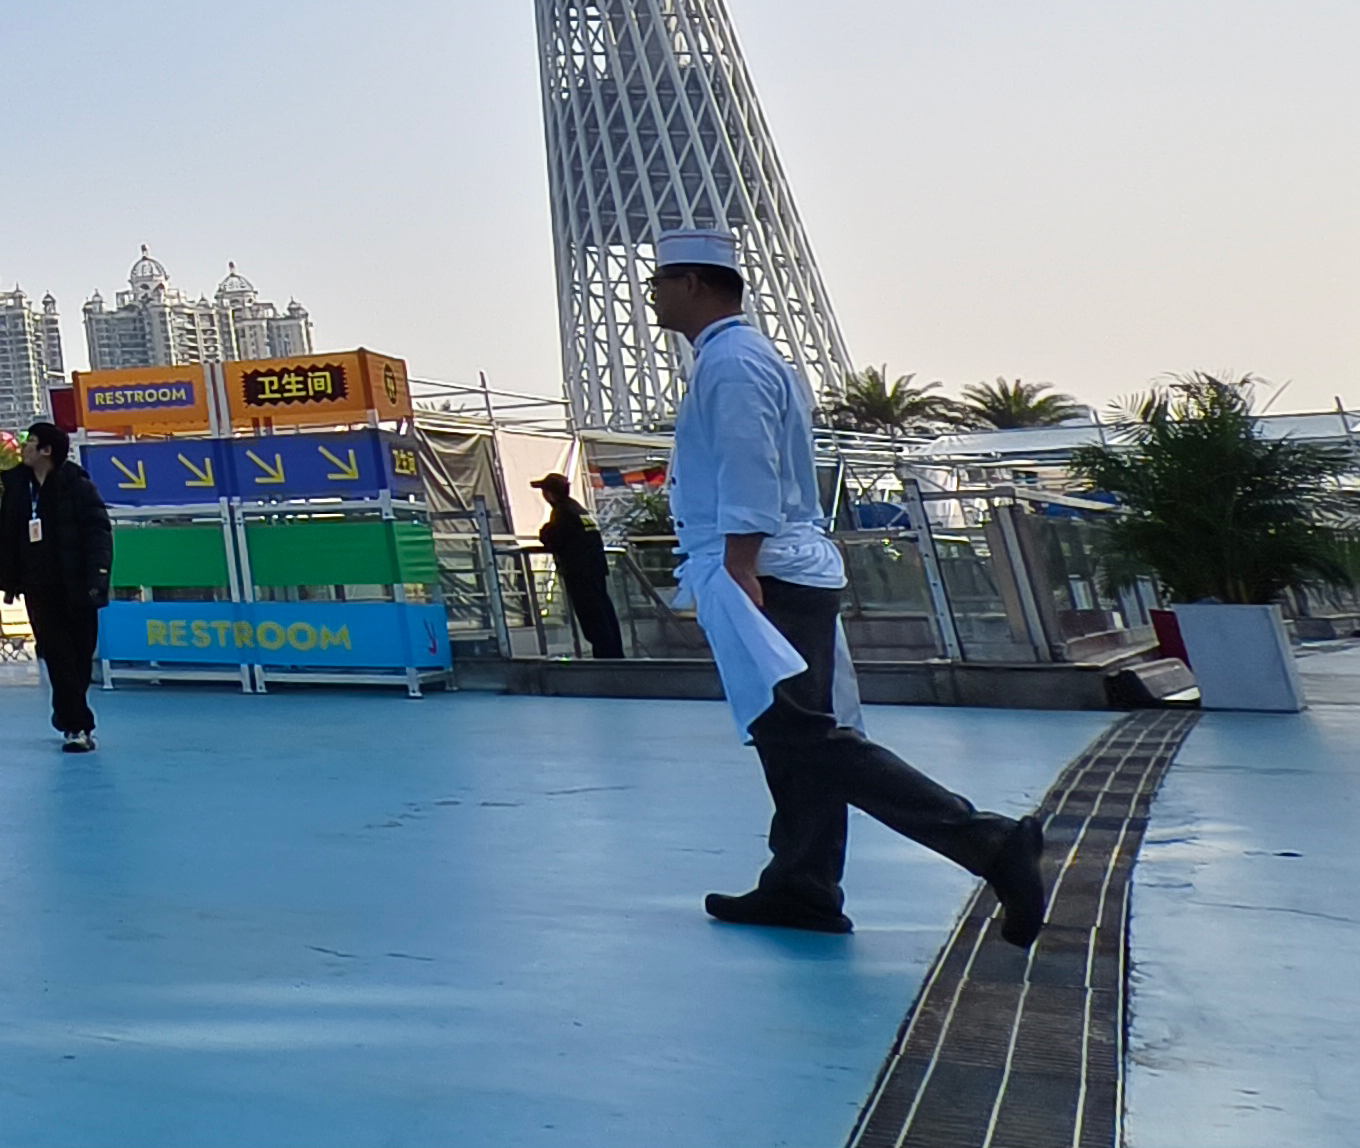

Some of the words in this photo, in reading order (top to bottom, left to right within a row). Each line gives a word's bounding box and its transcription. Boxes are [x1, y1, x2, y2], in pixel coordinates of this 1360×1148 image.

[94, 387, 187, 405] RESTROOM
[256, 370, 333, 399] 卫生间
[146, 618, 352, 651] RESTROOM
